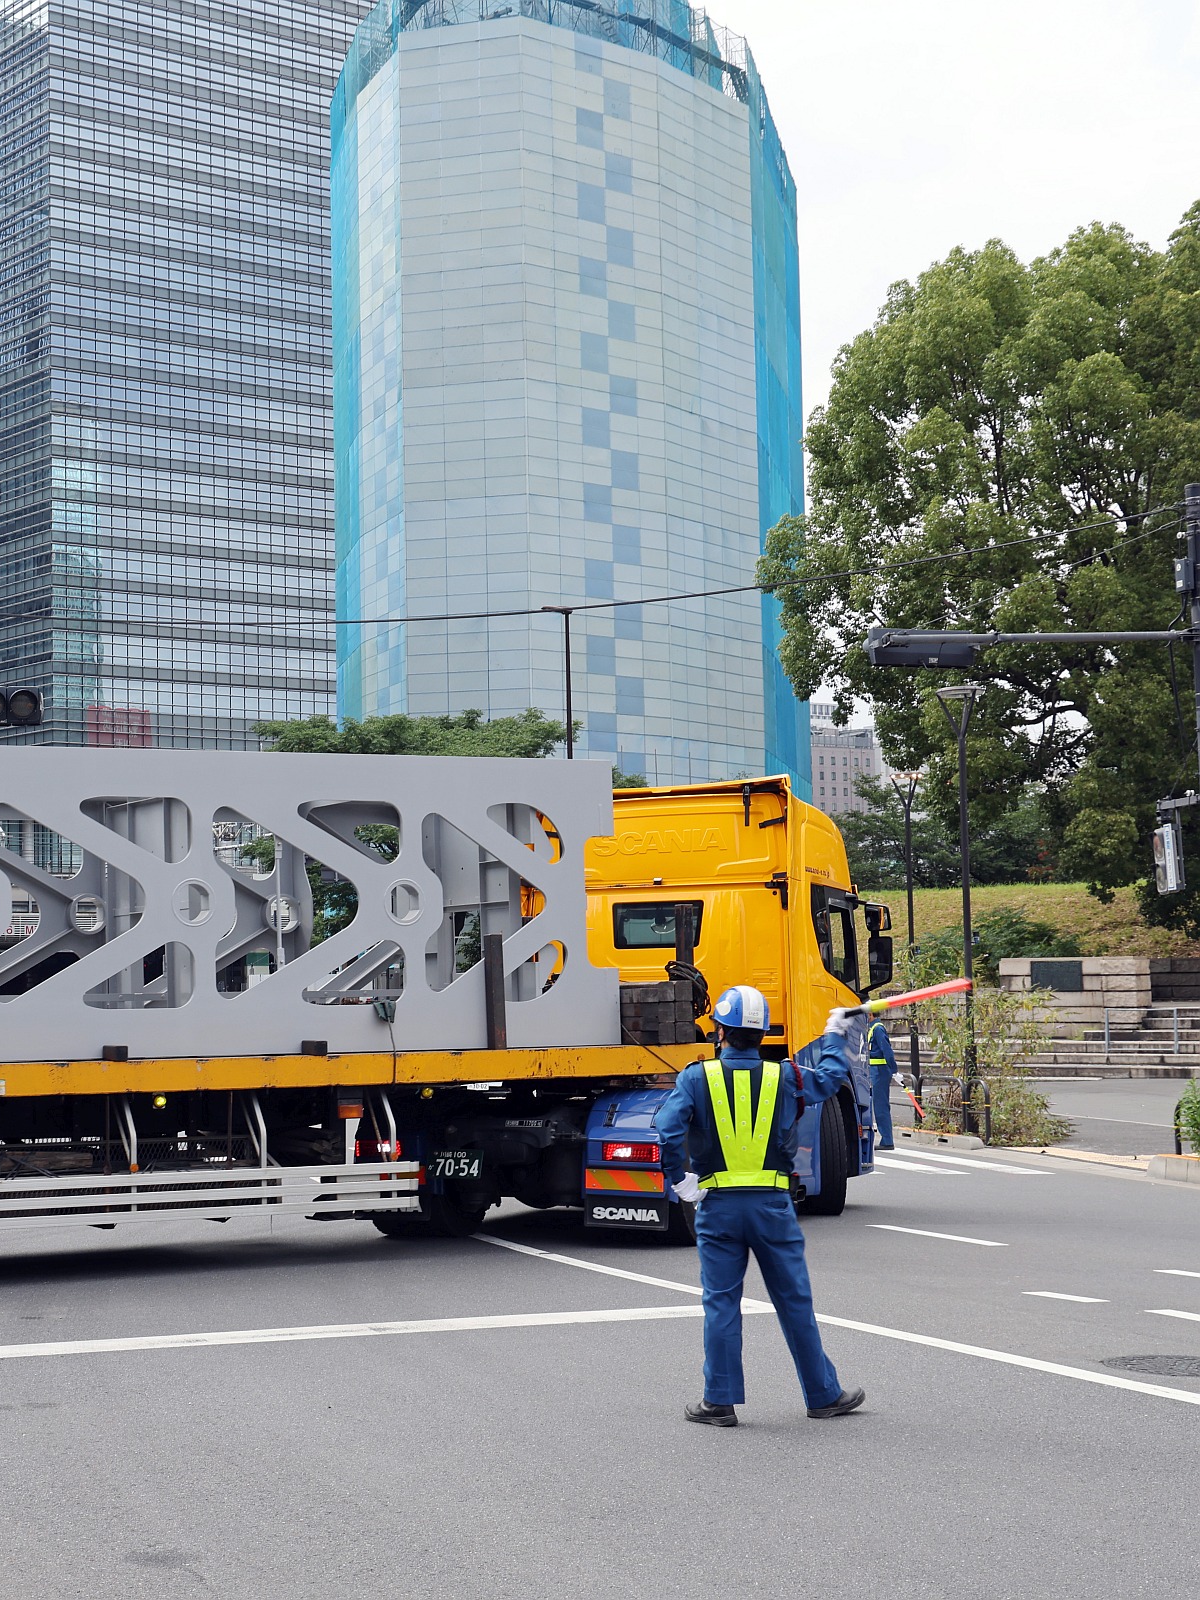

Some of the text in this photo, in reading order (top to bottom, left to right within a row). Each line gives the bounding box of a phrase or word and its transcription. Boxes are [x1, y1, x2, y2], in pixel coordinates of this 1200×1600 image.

[593, 828, 727, 857] SCANIA
[435, 1158, 479, 1177] 70-54
[592, 1206, 660, 1222] SCANIA
